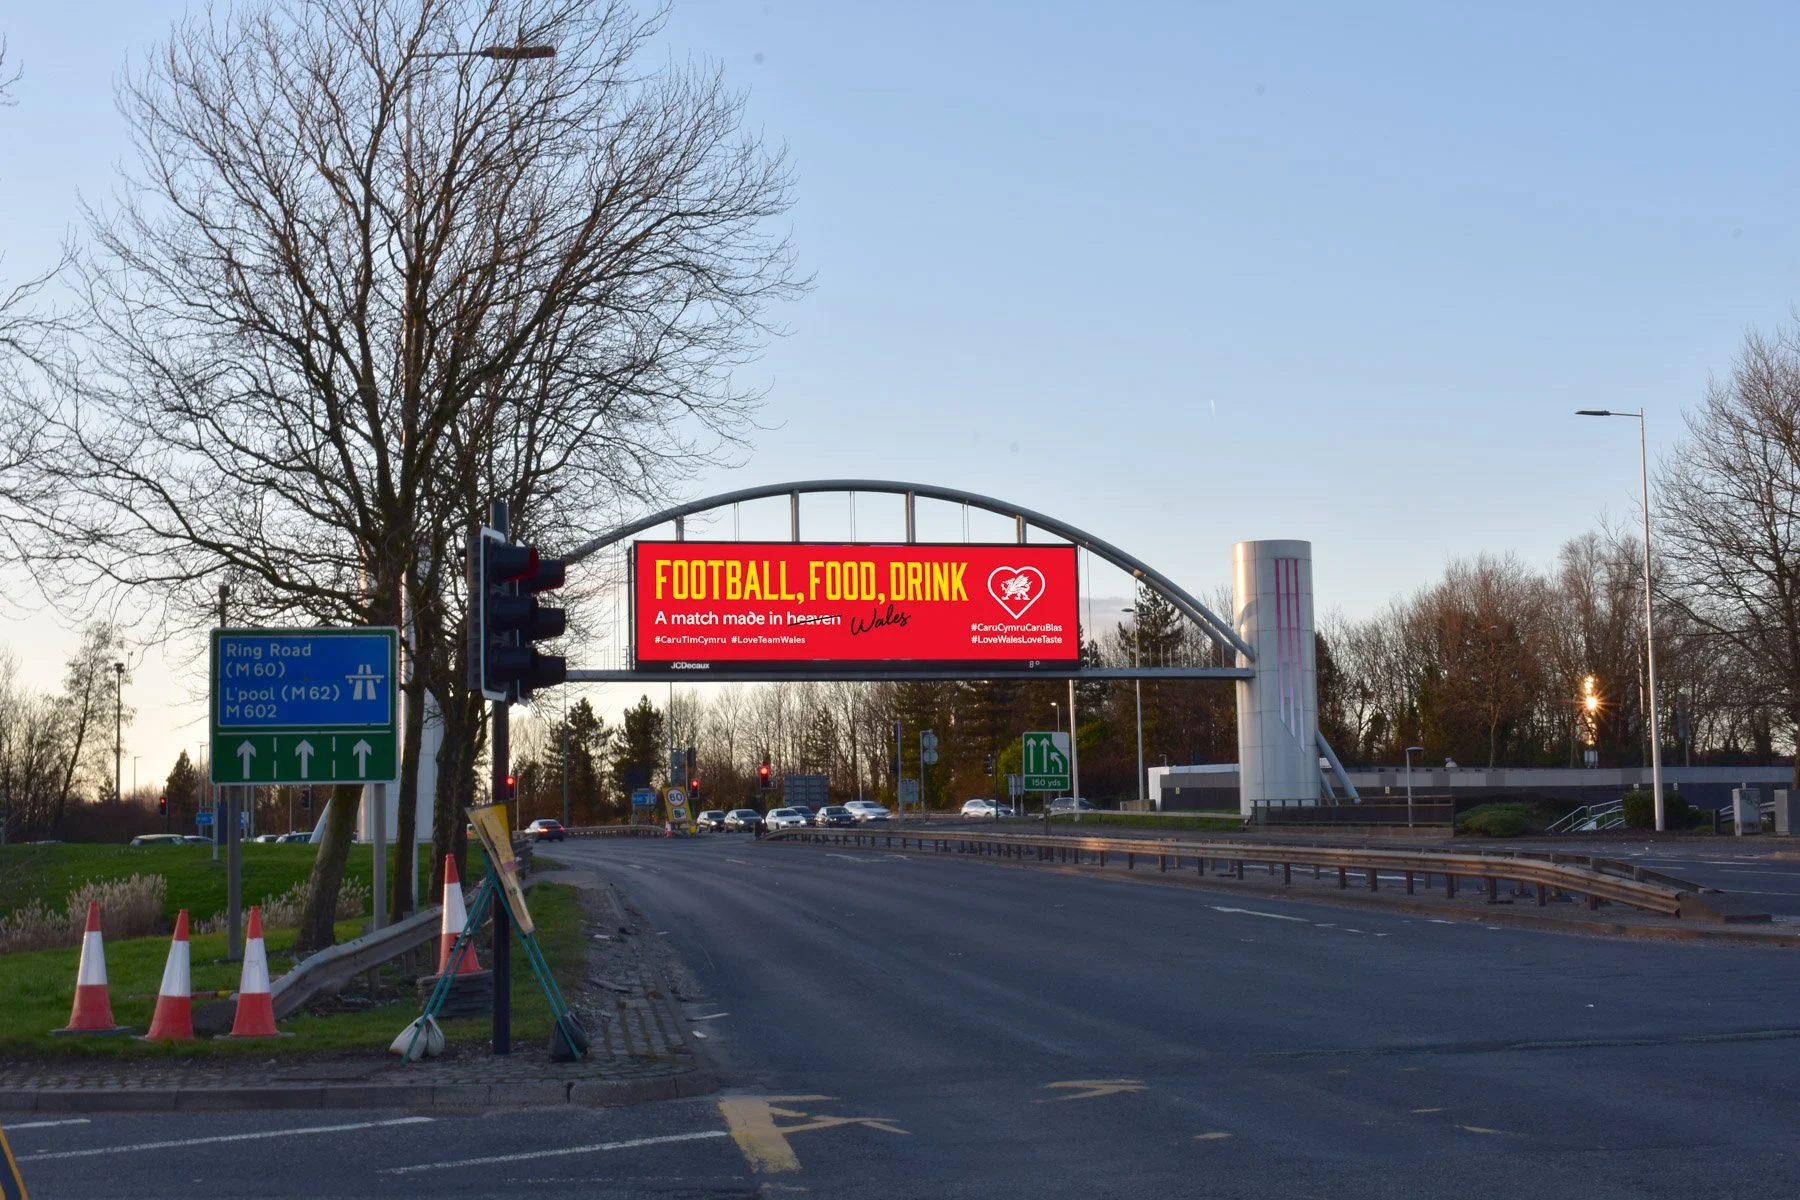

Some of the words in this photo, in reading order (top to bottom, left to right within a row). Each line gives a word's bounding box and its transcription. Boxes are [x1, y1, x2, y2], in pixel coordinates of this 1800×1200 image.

[655, 560, 804, 604] FOOTBALL,
[809, 561, 885, 604] FOOD,
[890, 562, 968, 600] DRINK
[655, 611, 667, 625] A
[671, 611, 718, 625] match
[723, 611, 765, 625] made
[769, 611, 783, 625] in
[787, 611, 841, 626] heaven
[851, 604, 911, 635] Wales
[971, 623, 1063, 633] #CaruCymruCaruBlas
[731, 635, 806, 644] #LoveTeamWales
[971, 635, 1063, 644] #LoveWalesLoveTaste
[226, 643, 262, 660] Ring
[270, 643, 312, 657] Road
[225, 661, 286, 678] (M60)
[670, 661, 710, 669] JCDecaux
[226, 685, 275, 703] L'pool
[281, 685, 340, 702] (M62)
[226, 704, 277, 719] M602
[1048, 779, 1061, 787] yds
[669, 793, 683, 802] 60
